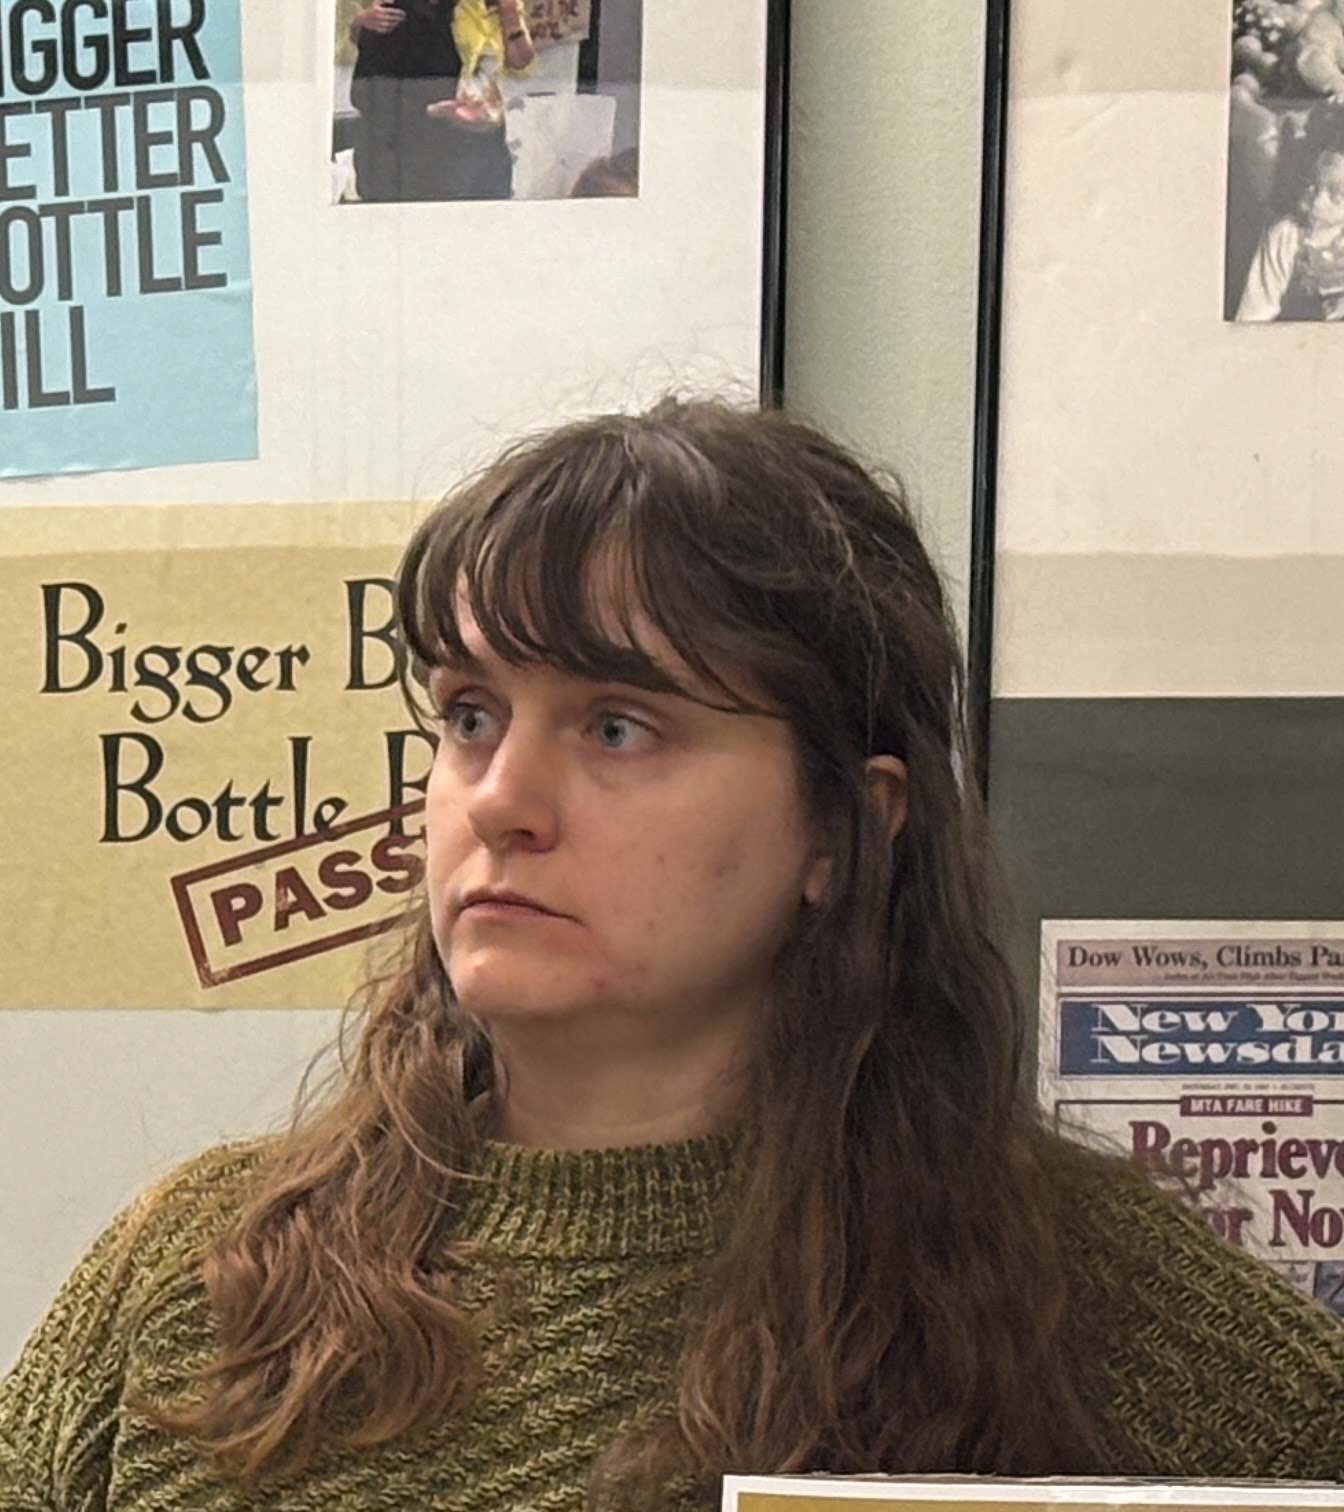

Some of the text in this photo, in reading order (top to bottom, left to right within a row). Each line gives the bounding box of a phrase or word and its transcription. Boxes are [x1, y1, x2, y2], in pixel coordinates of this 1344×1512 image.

[38, 580, 312, 724] Bigger
[98, 731, 350, 844] Bottle
[1068, 945, 1344, 970] Dow Wows, Climbs Pa
[1091, 1003, 1239, 1033] New
[1190, 1098, 1303, 1113] MTA FARE HIKE
